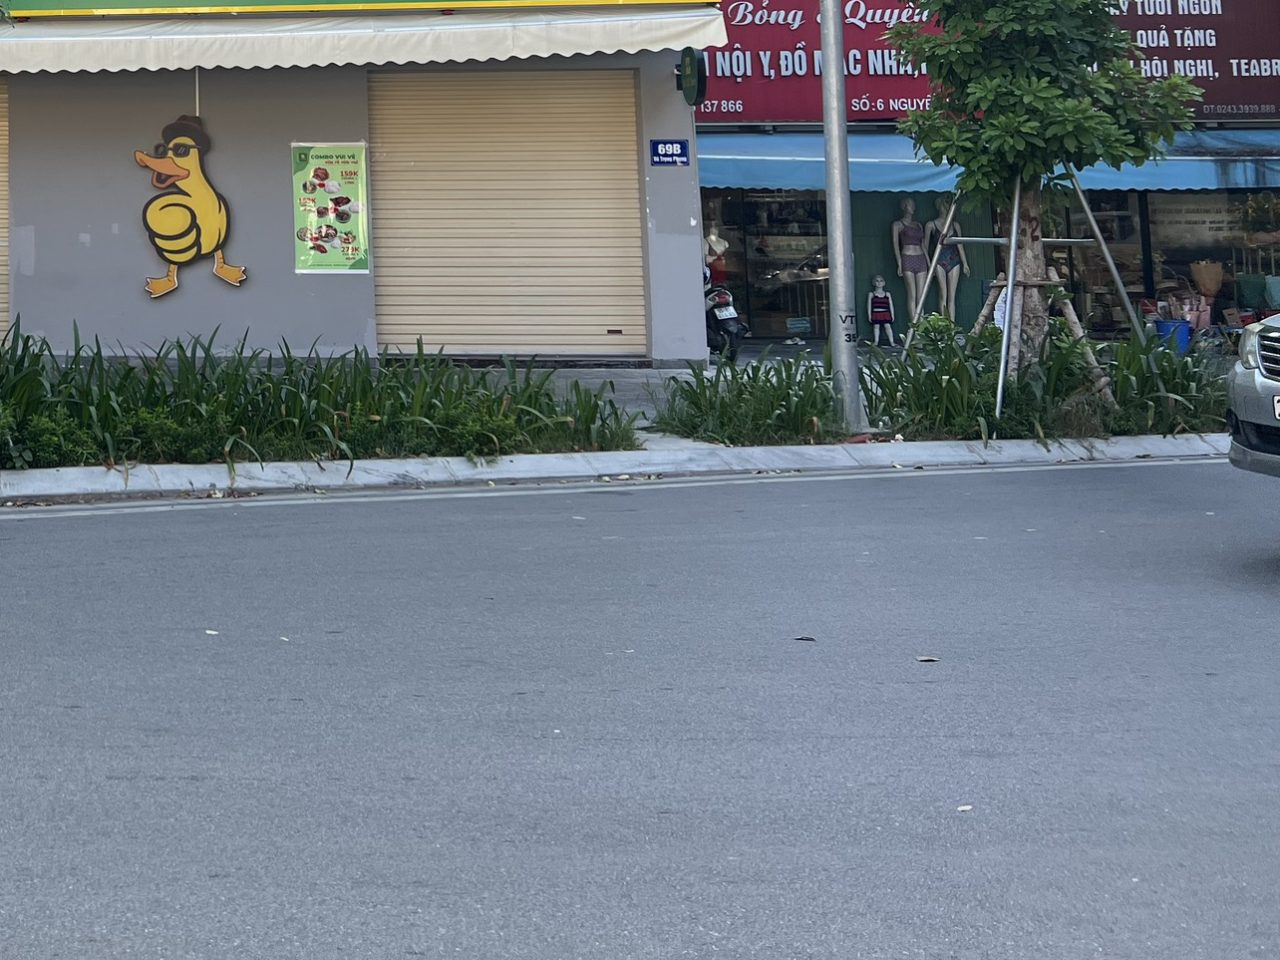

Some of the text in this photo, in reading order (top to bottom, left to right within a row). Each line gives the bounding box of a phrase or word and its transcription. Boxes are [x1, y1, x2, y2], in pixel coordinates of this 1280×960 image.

[1136, 24, 1217, 51] QUẢ TẶNG
[715, 43, 753, 83] NỘI
[759, 50, 776, 80] Y,
[779, 41, 808, 76] ĐỒ
[1173, 59, 1220, 81] NGHỊ,
[721, 100, 743, 113] 866
[657, 143, 682, 155] 69B
[838, 314, 857, 325] VT
